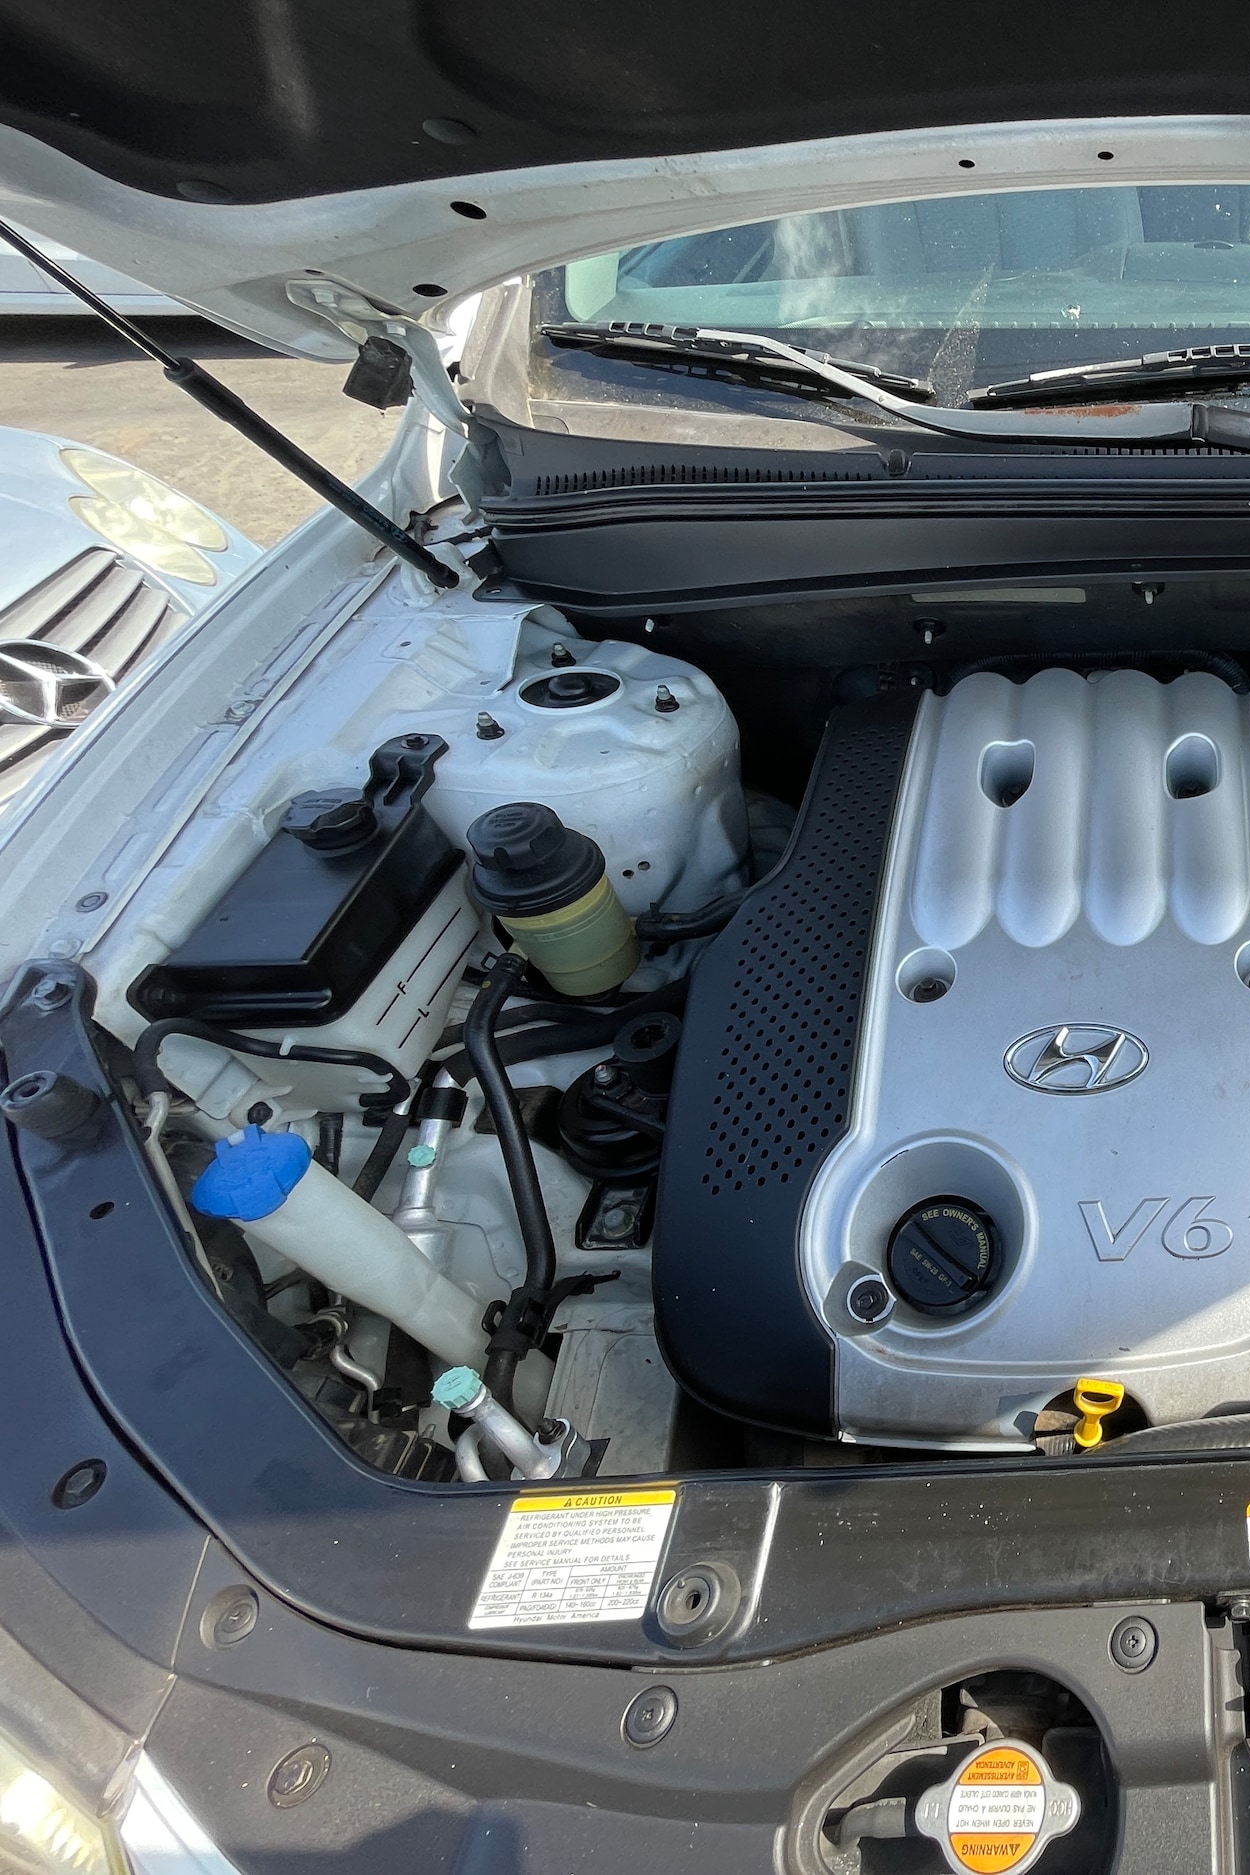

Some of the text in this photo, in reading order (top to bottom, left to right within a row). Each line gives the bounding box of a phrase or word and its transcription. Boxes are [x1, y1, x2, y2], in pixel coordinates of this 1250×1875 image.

[397, 981, 406, 995] F
[418, 1008, 429, 1018] L
[1078, 1195, 1233, 1262] V6
[922, 1208, 987, 1270] SEE OWNER'S MANUAL
[910, 1247, 922, 1261] SAE
[575, 1495, 622, 1507] CAUTION
[520, 1512, 570, 1521] REFRIGERANT
[570, 1510, 594, 1519] UNDER
[595, 1509, 614, 1517] HIGH
[532, 1520, 587, 1530] CONDITIONING
[588, 1518, 619, 1526] SYSTEM
[514, 1531, 551, 1540] SERVICED
[563, 1528, 600, 1538] QUALIFIED
[510, 1541, 548, 1550] IMPROPER
[548, 1538, 578, 1547] SERVICE
[580, 1536, 615, 1545] METHODS
[631, 1534, 656, 1542] CAUSE
[507, 1548, 573, 1559] PERSONAL INJURY
[503, 1560, 519, 1569] SEE
[520, 1558, 551, 1568] SERVICE
[552, 1556, 582, 1566] MANUAL
[600, 1554, 630, 1563] DETAILS
[541, 1569, 558, 1577] TYPE
[600, 1564, 627, 1573] AMOUNT
[513, 1612, 600, 1624] Hyundai Motor America
[975, 1761, 1015, 1769] ADVERTENCIA
[967, 1772, 1015, 1780] AVERTISSEMENT
[924, 1802, 940, 1819] 1.1
[958, 1804, 979, 1813] CHAUD
[988, 1804, 1011, 1813] OUVRIR
[1013, 1804, 1025, 1813] PAS
[1027, 1804, 1036, 1813] NE
[956, 1818, 1034, 1828] NEVER OPEN WHEN HOT
[962, 1844, 1008, 1856] WARNING
